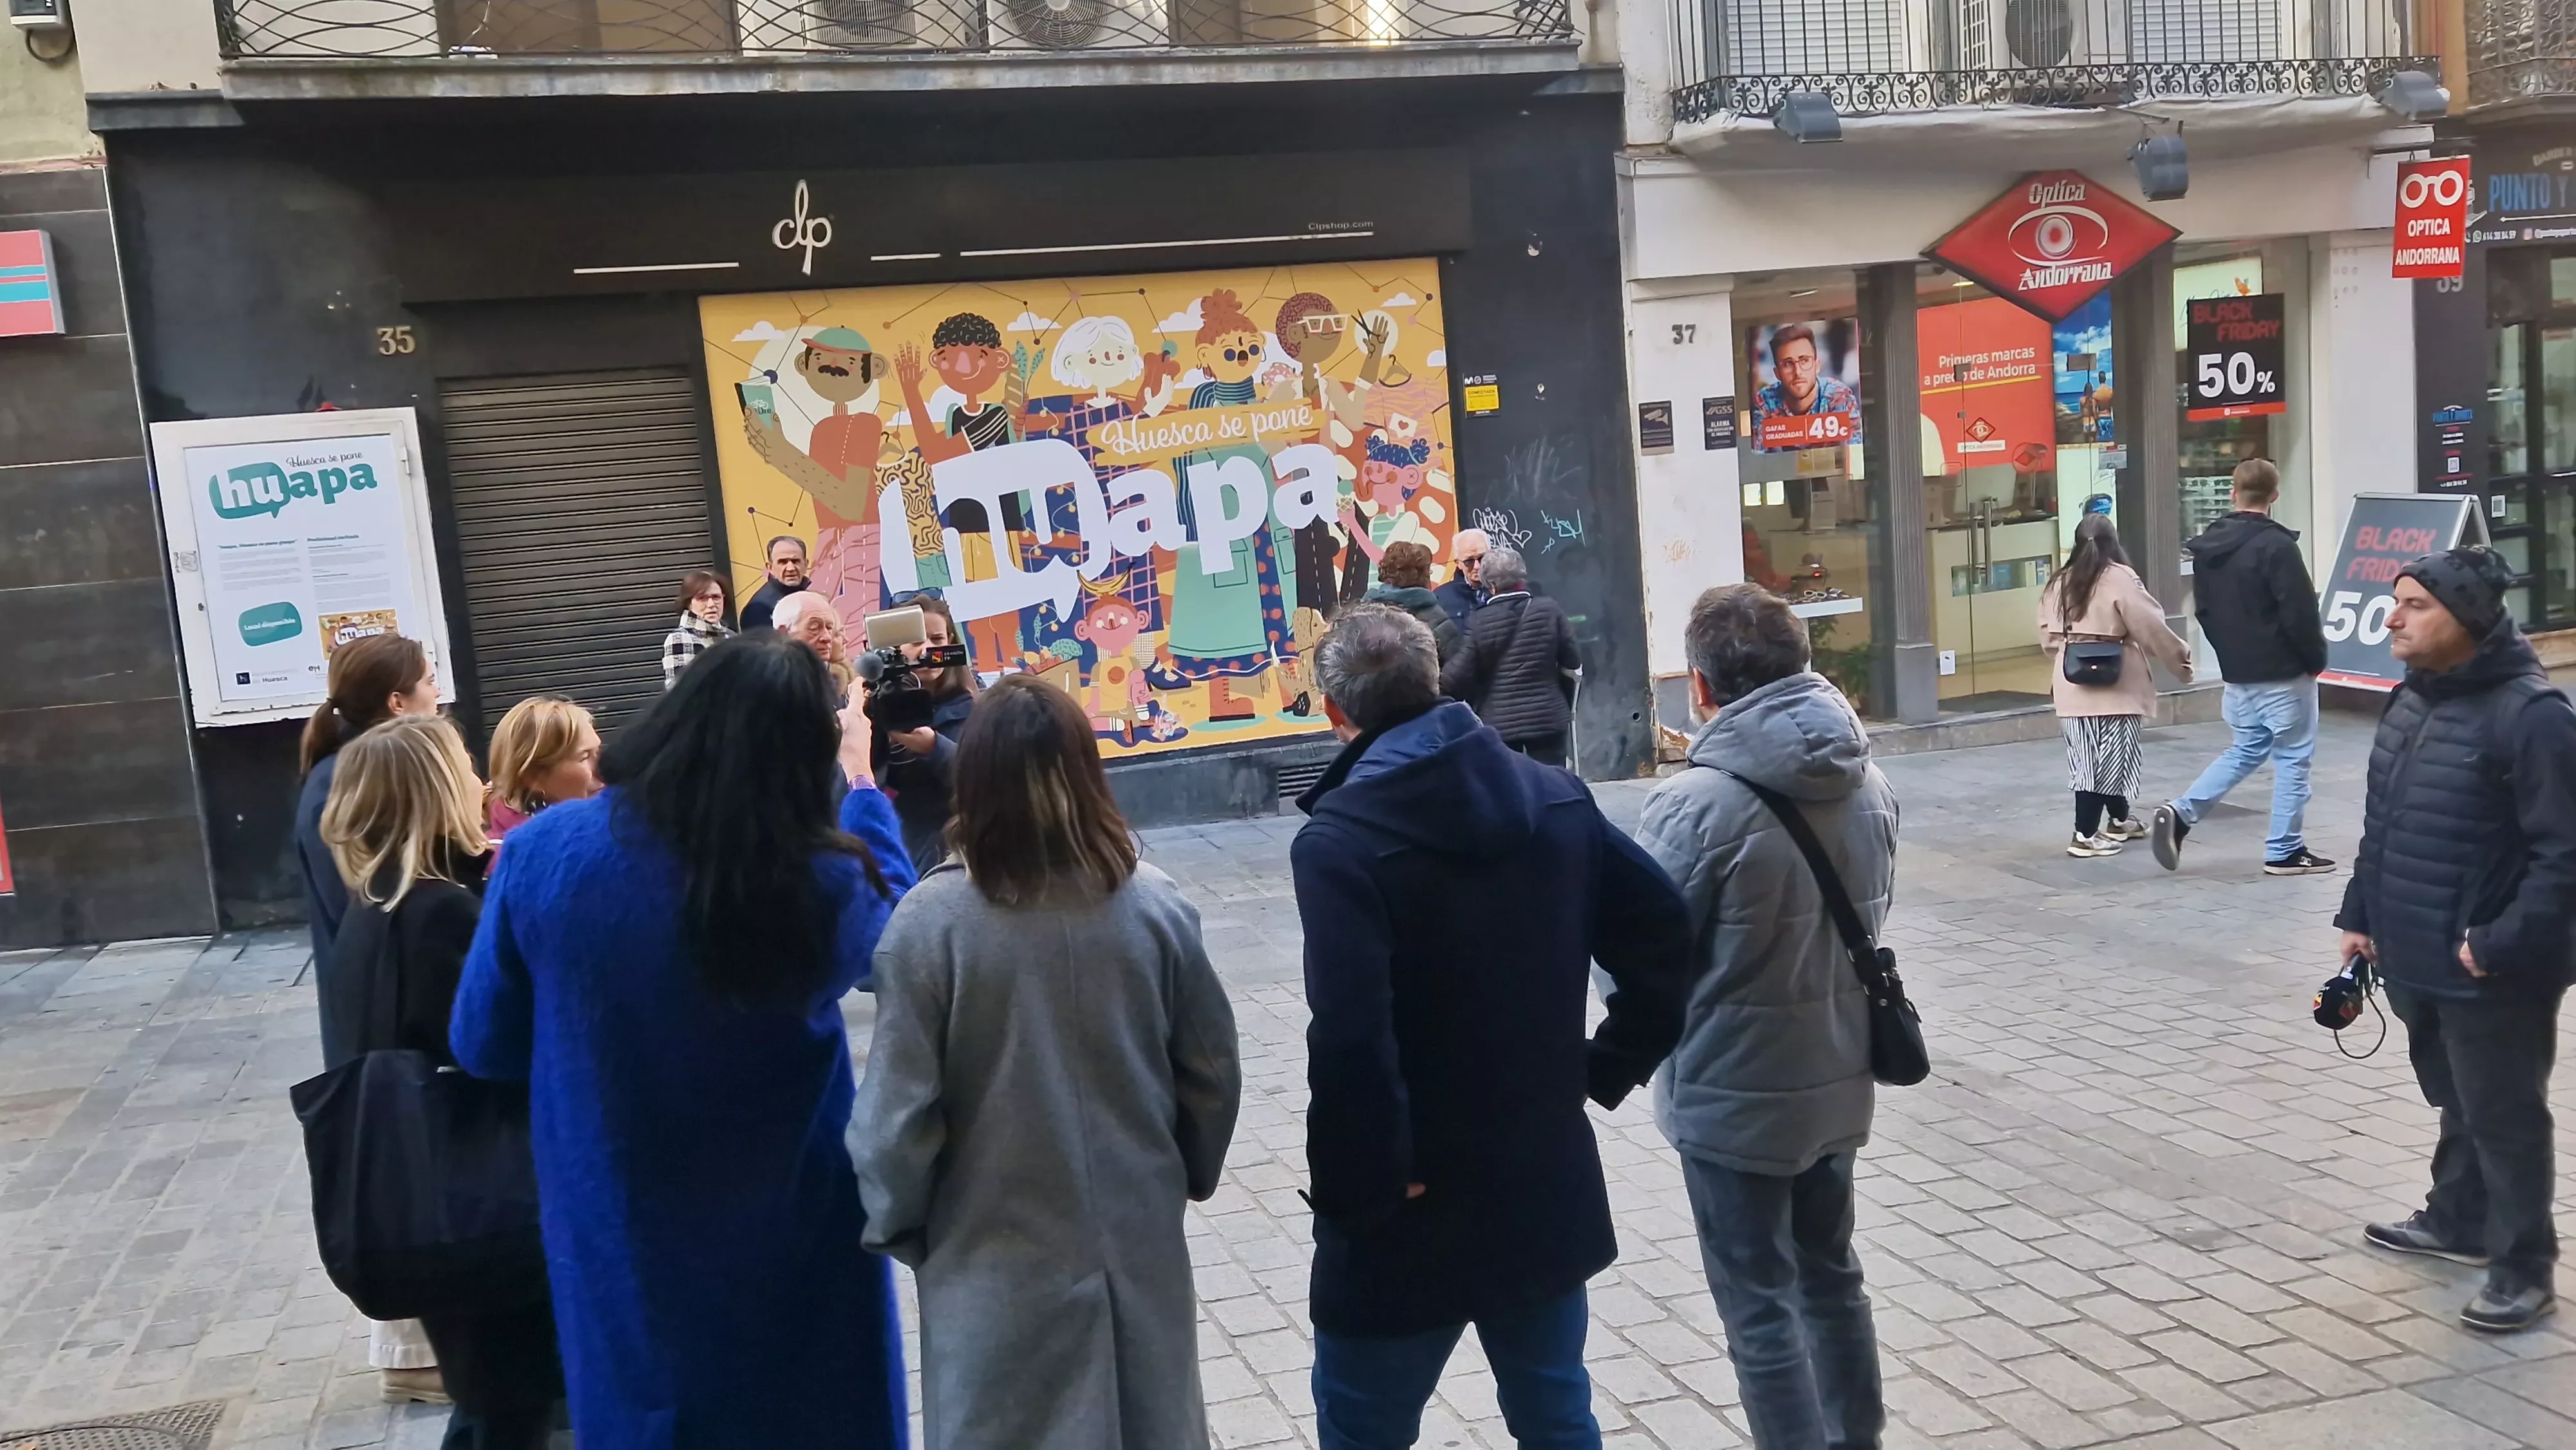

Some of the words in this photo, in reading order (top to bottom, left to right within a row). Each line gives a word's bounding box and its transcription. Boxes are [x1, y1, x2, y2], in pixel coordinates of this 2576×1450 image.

[2488, 173, 2551, 212] PUNTO
[2557, 176, 2569, 207] Y
[2407, 218, 2450, 237] OPTICA
[2395, 247, 2460, 265] ANDORRANA
[2018, 261, 2113, 291] Andorrana
[2193, 302, 2254, 324] BLACK
[376, 326, 415, 355] 35
[1672, 323, 1696, 344] 37
[2217, 320, 2280, 342] FRIDAY
[1939, 351, 1989, 368] Primeras
[1991, 346, 2035, 362] marcas
[1924, 376, 1931, 386] a
[1970, 368, 1985, 381] de
[1987, 363, 2036, 379] Andorra
[2198, 352, 2276, 398] 50%
[1100, 415, 1213, 456] Huesca
[1218, 414, 1246, 438] se
[1250, 404, 1313, 442] pone
[1765, 431, 1804, 440] GRADUADAS
[286, 455, 327, 467] Huesca
[328, 454, 338, 462] se
[213, 463, 377, 513] huapa
[2355, 525, 2438, 552] BLACK
